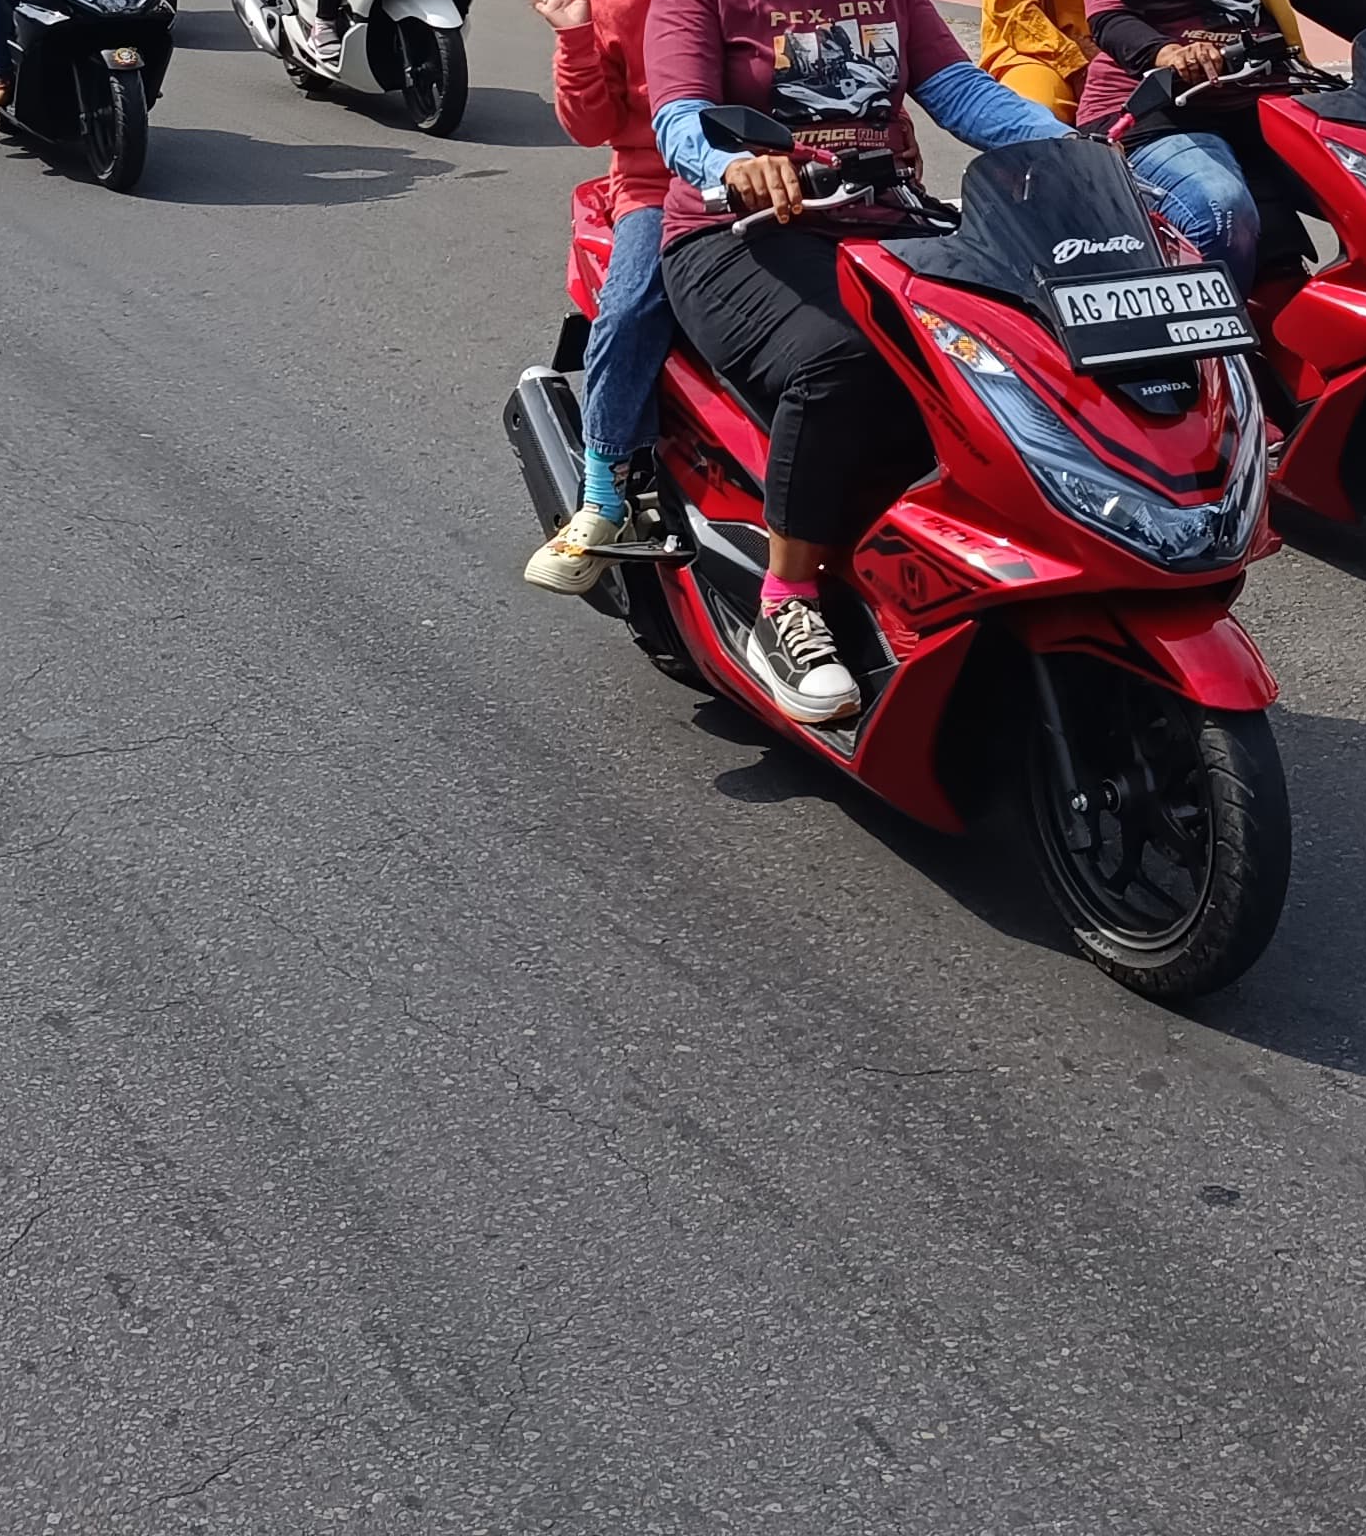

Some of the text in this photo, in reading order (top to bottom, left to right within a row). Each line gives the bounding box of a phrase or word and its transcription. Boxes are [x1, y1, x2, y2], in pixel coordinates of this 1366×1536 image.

[771, 0, 886, 27] PCX DAY
[1052, 234, 1145, 264] Dinata
[1067, 294, 1102, 325] AG
[1106, 284, 1175, 321] 2078
[1140, 382, 1192, 395] HONDA
